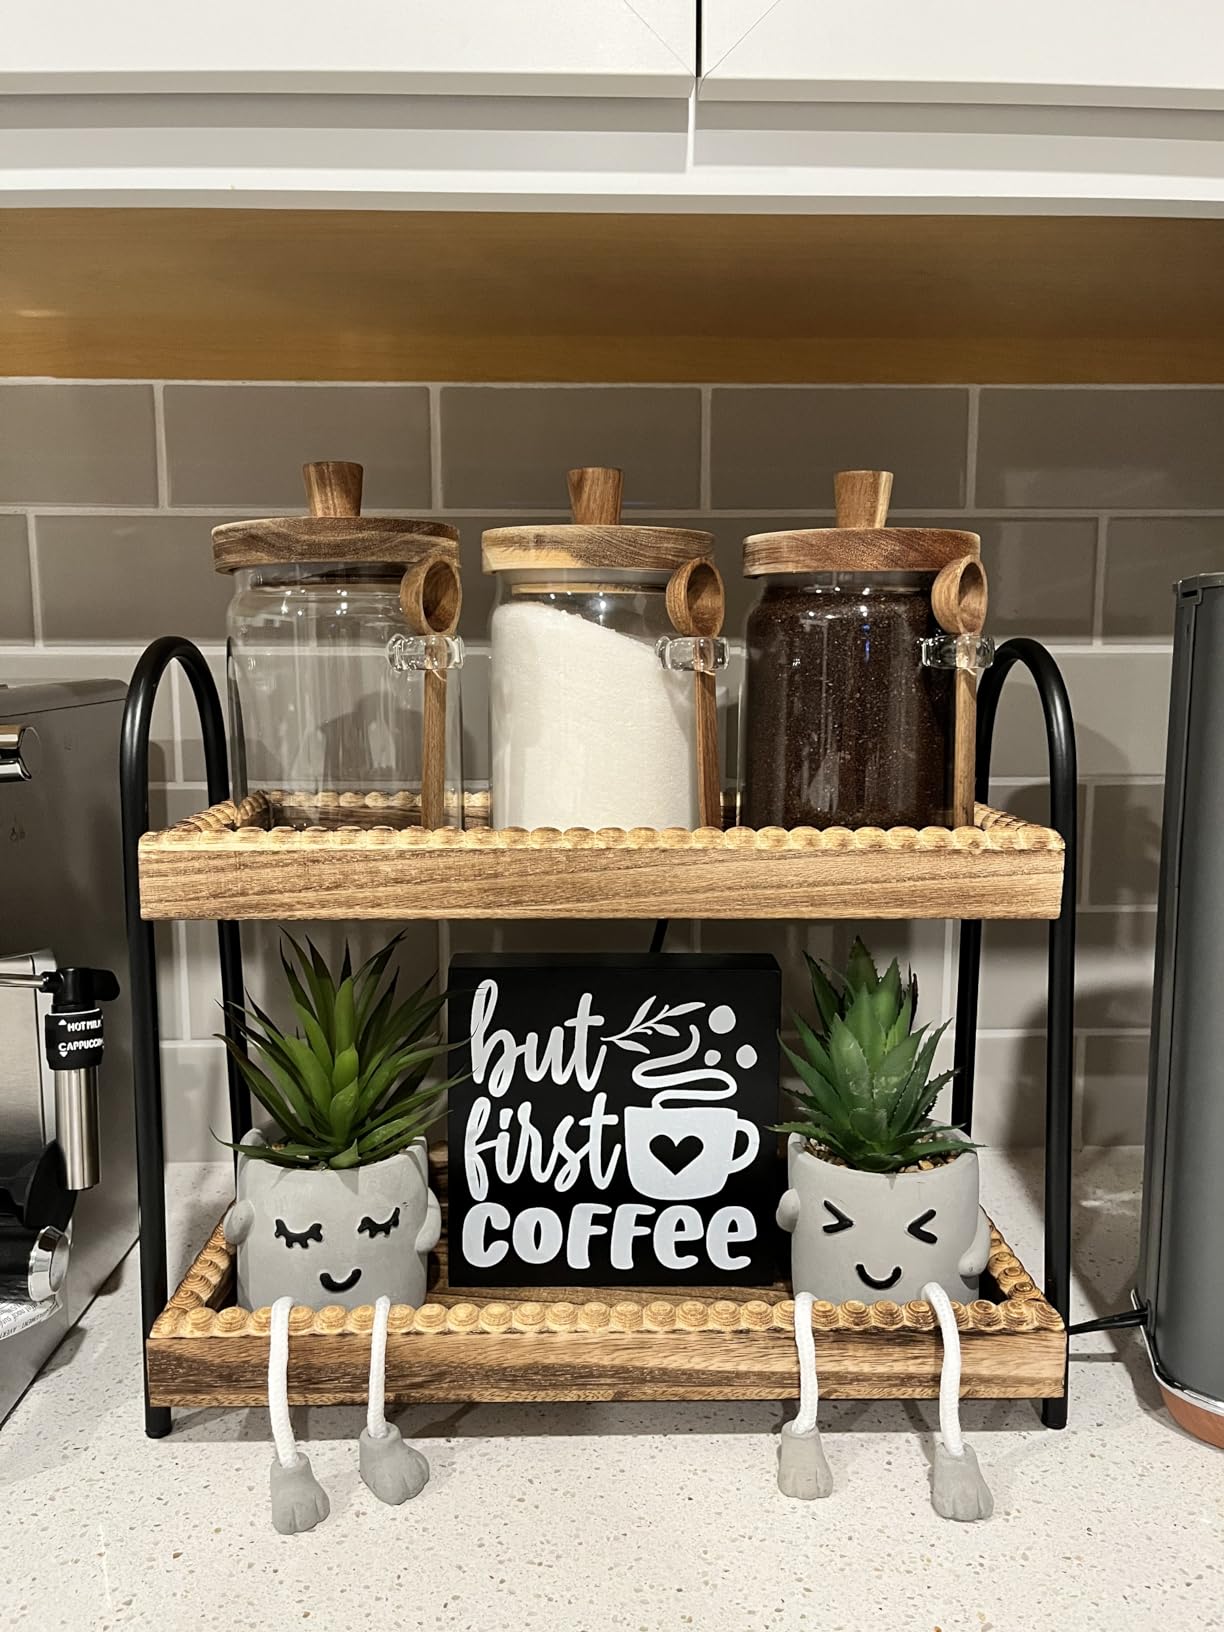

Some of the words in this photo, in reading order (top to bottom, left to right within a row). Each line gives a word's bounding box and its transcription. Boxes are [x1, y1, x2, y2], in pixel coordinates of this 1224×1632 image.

[67, 1021, 86, 1032] HOT
[471, 979, 607, 1097] but
[465, 1092, 621, 1201] first
